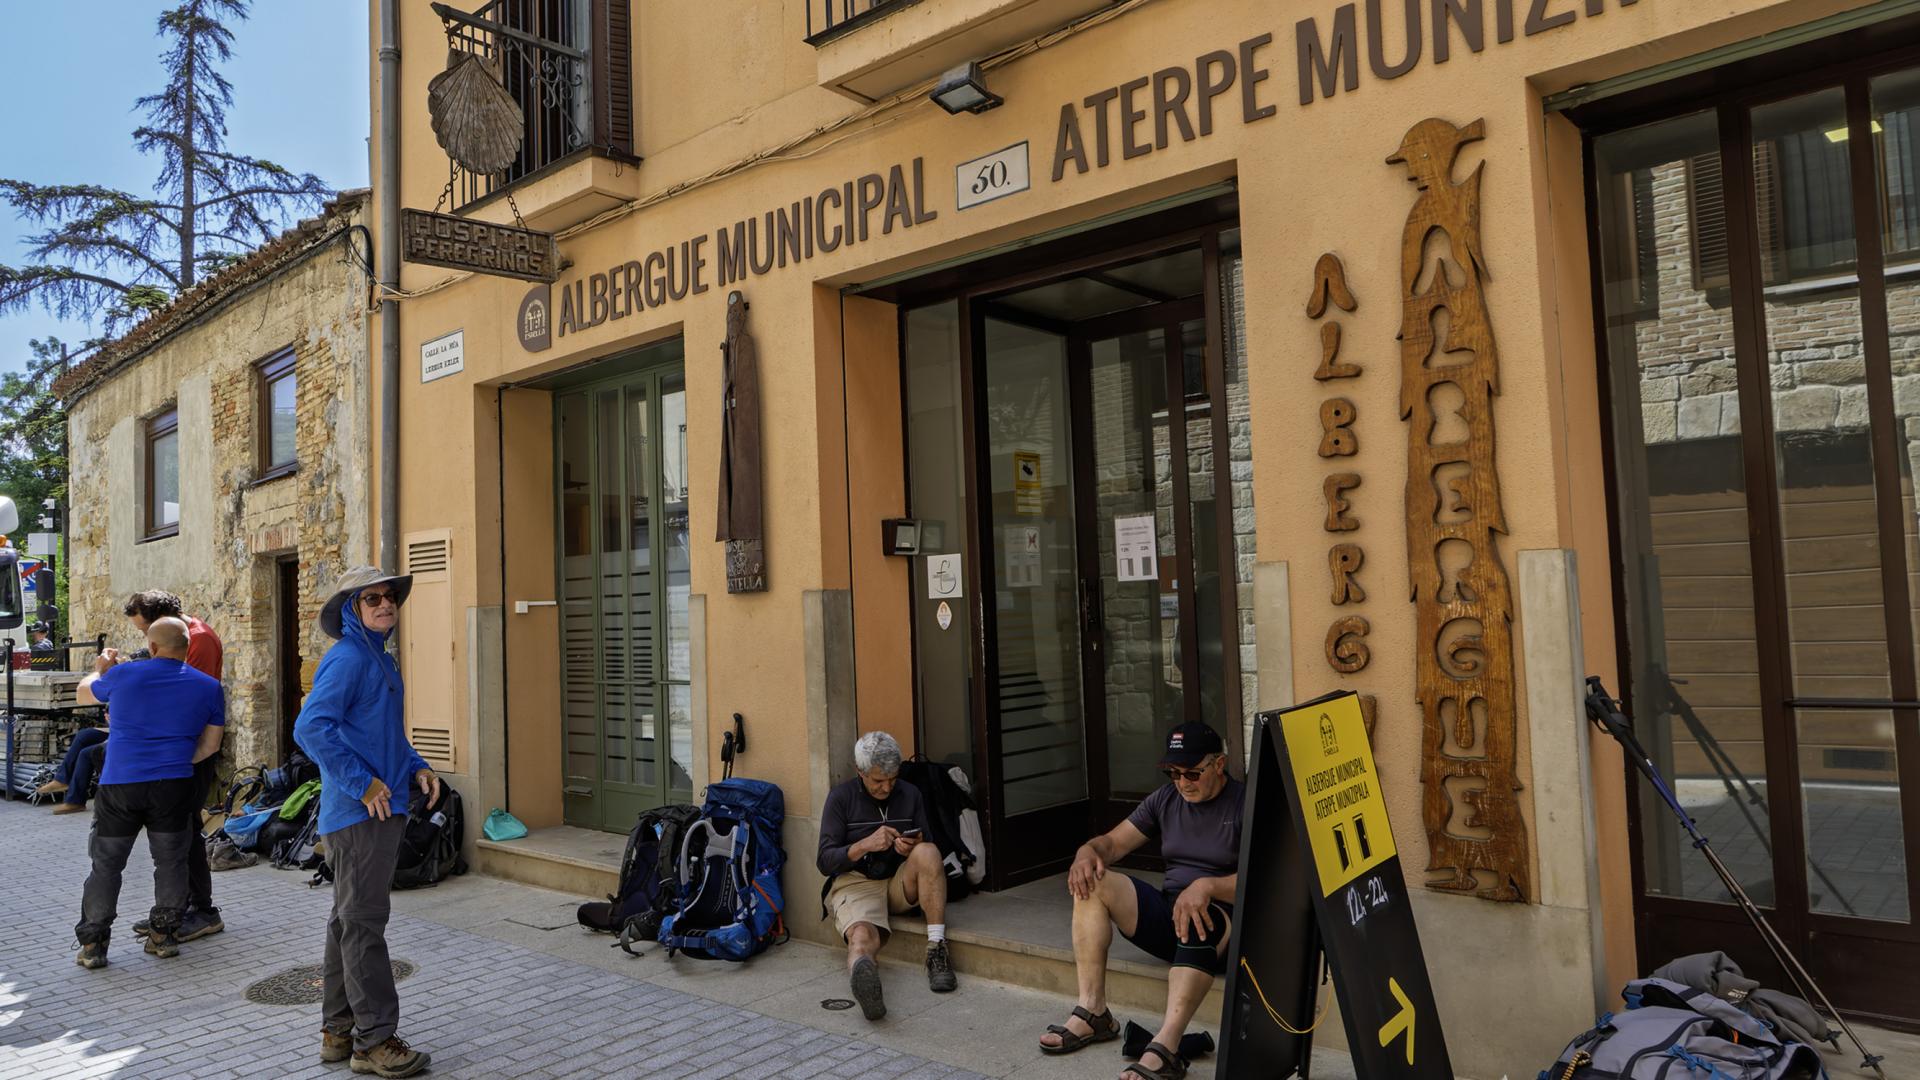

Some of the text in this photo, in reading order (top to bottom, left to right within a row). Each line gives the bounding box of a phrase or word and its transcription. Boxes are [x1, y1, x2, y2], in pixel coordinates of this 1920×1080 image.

[1051, 32, 1277, 183] ATERPE
[411, 237, 543, 275] PEREGRINOS
[413, 213, 545, 254] HOSPITAL
[558, 156, 937, 338] ALBERGUE MUNICIPAL
[1306, 252, 1378, 750] ALBERG
[1411, 224, 1495, 842] ALBERGUE
[1305, 756, 1367, 797] ALBERGUE MUNICIPAL
[1314, 780, 1371, 822] ATERPE MUNIZIPALA
